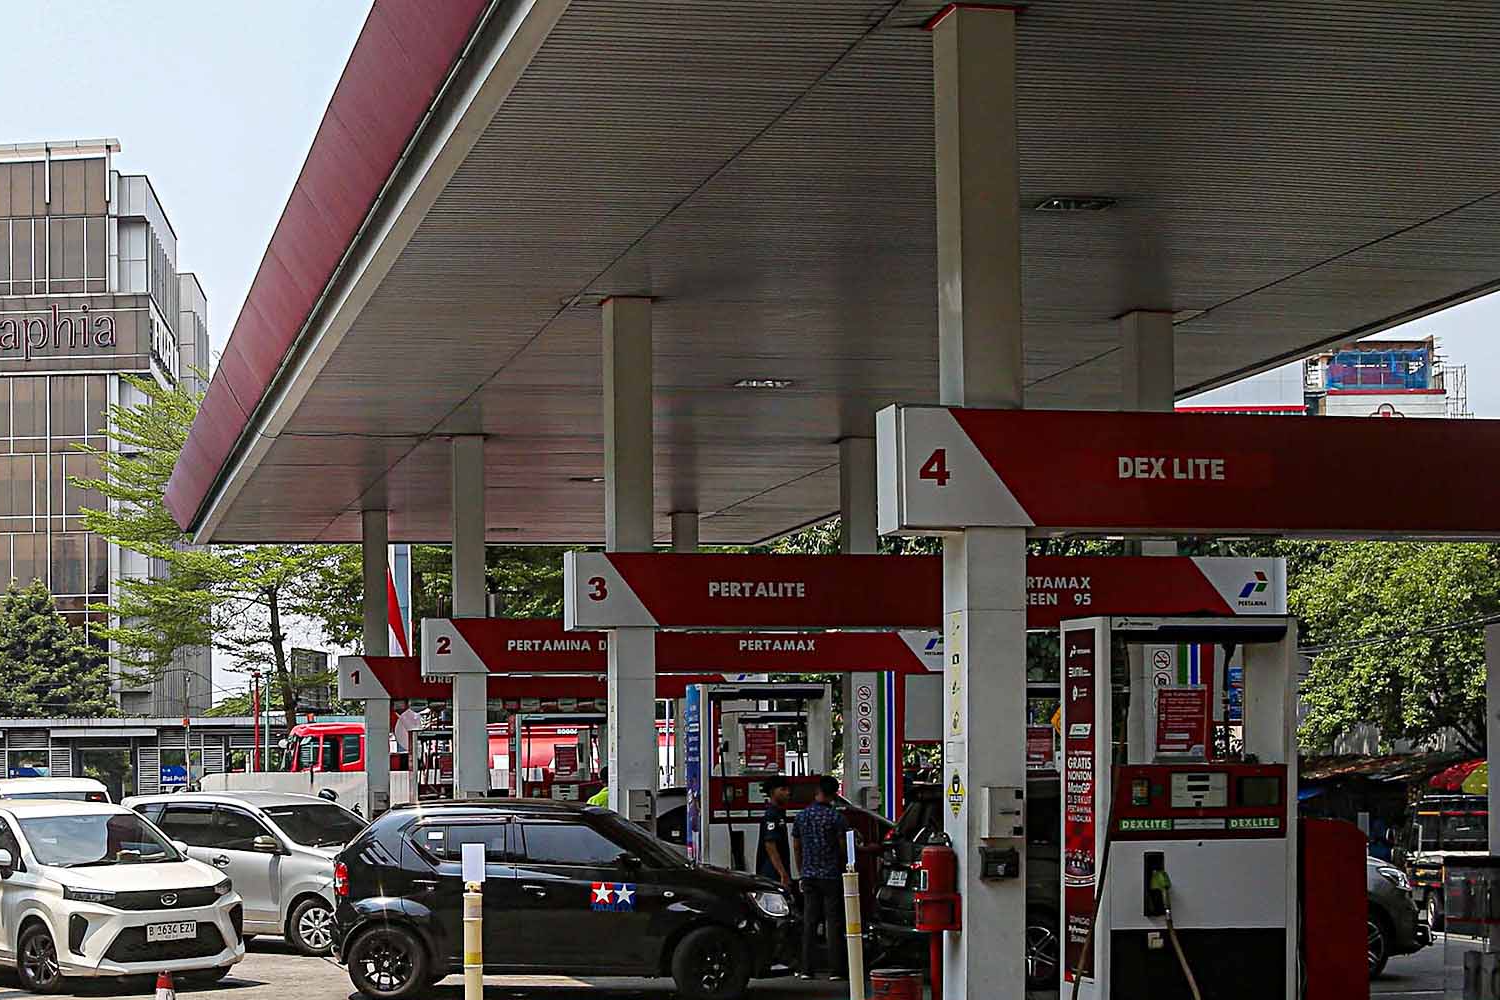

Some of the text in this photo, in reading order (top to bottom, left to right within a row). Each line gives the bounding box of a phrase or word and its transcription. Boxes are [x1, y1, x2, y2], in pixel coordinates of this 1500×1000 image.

[918, 448, 951, 487] 4
[1117, 456, 1226, 481] DEX LITE
[587, 576, 608, 601] 3
[1026, 576, 1091, 589] RTAMAX
[708, 581, 806, 598] PERTALITE
[1026, 593, 1091, 605] EEN 95
[436, 637, 452, 655] 2
[507, 639, 591, 651] PERTAMINA
[738, 639, 816, 651] PERTAMAX
[350, 671, 360, 685] 1
[420, 674, 453, 684] TURB
[1067, 756, 1092, 769] GRATIS
[1122, 819, 1168, 829] DEXLITE
[1230, 817, 1275, 828] DEXLITE
